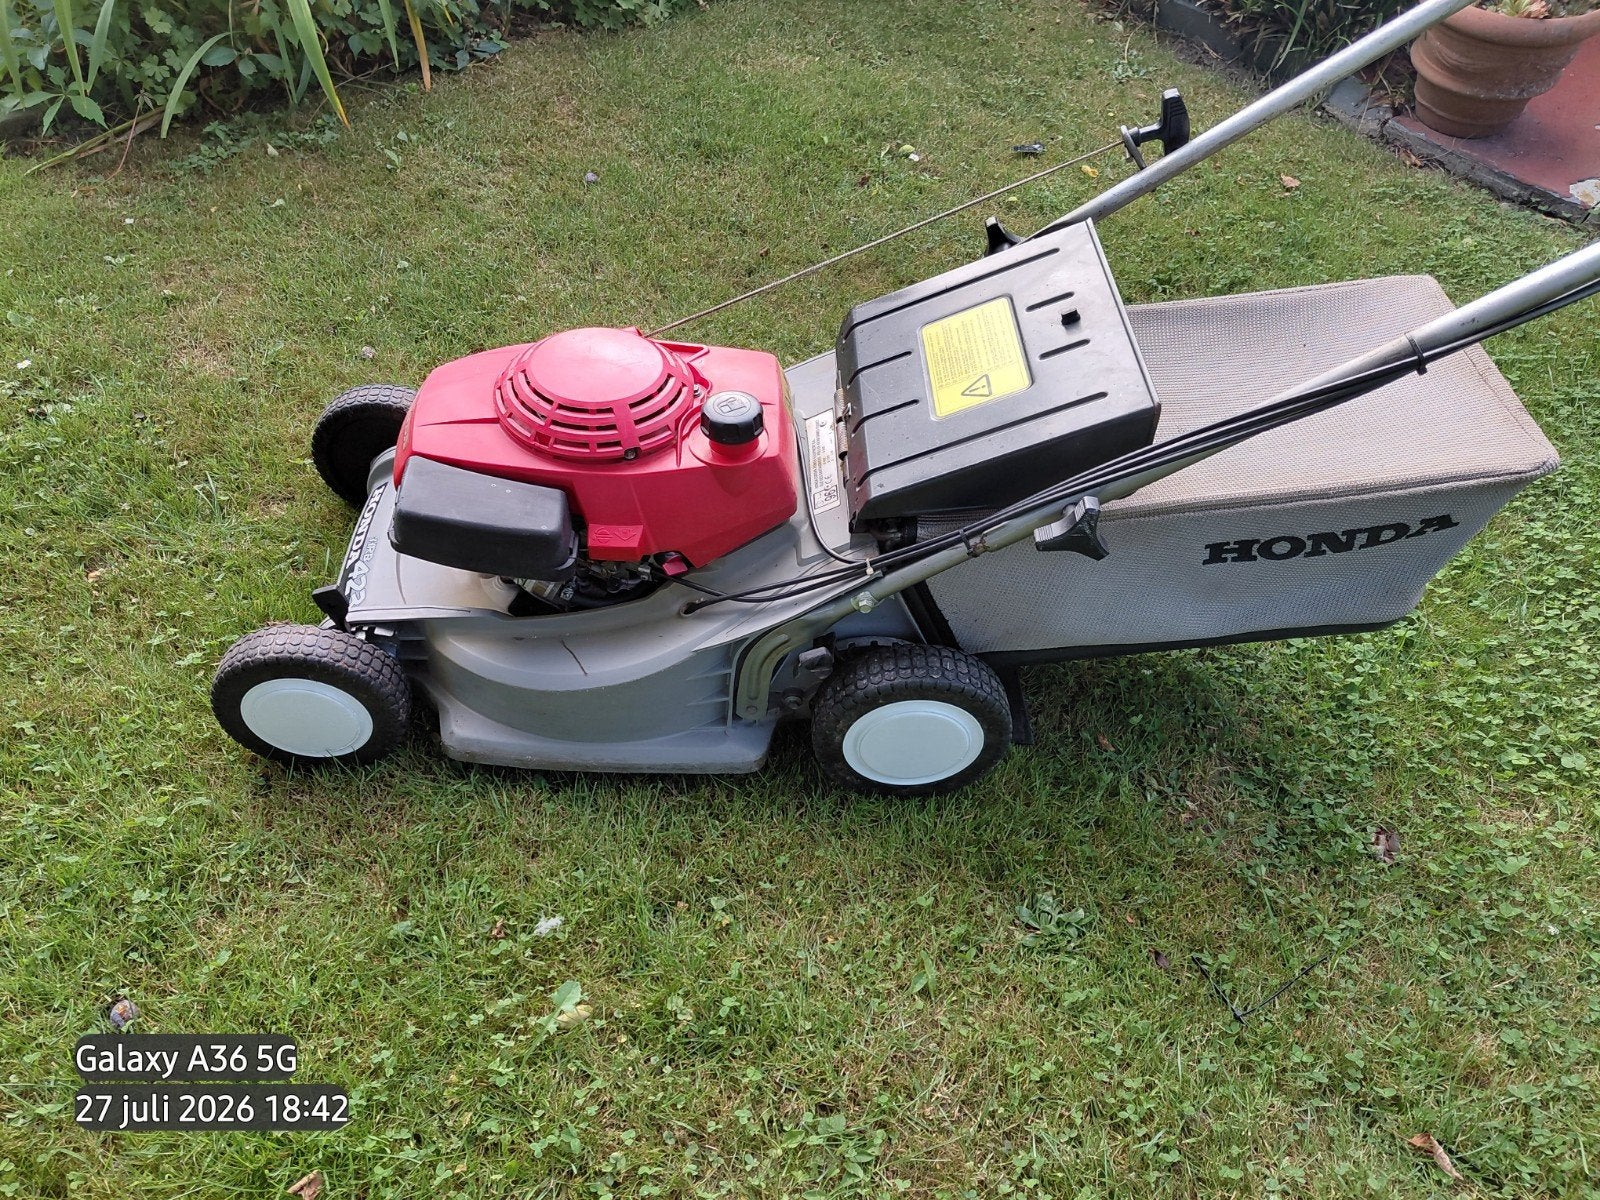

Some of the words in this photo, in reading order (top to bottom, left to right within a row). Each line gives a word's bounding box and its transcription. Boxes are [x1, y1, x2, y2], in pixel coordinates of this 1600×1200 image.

[346, 485, 384, 569] HONDA
[363, 537, 378, 562] HRB
[1202, 513, 1460, 565] HONDA
